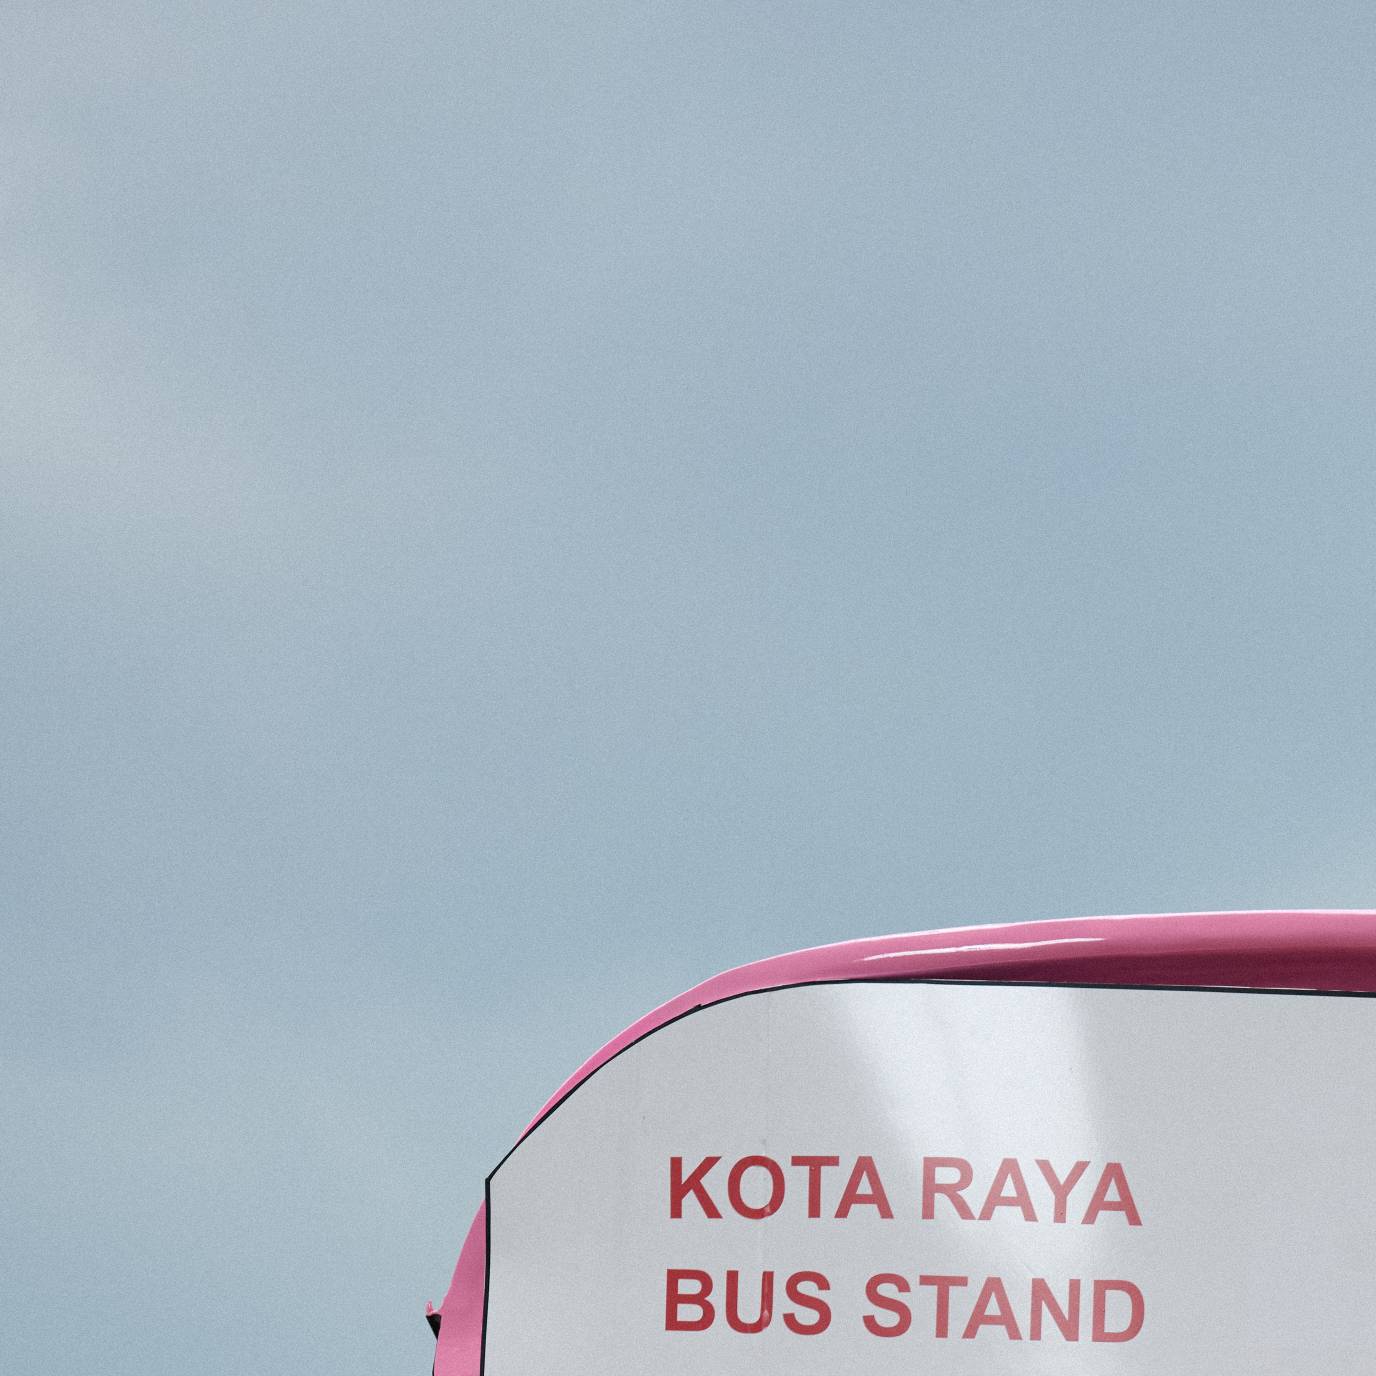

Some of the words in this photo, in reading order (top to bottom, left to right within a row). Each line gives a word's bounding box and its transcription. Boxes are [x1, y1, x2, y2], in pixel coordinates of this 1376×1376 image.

[669, 1155, 894, 1220] KOTA
[921, 1156, 1143, 1227] RAYA
[664, 1268, 832, 1336] BUS
[862, 1272, 1146, 1343] STAND
